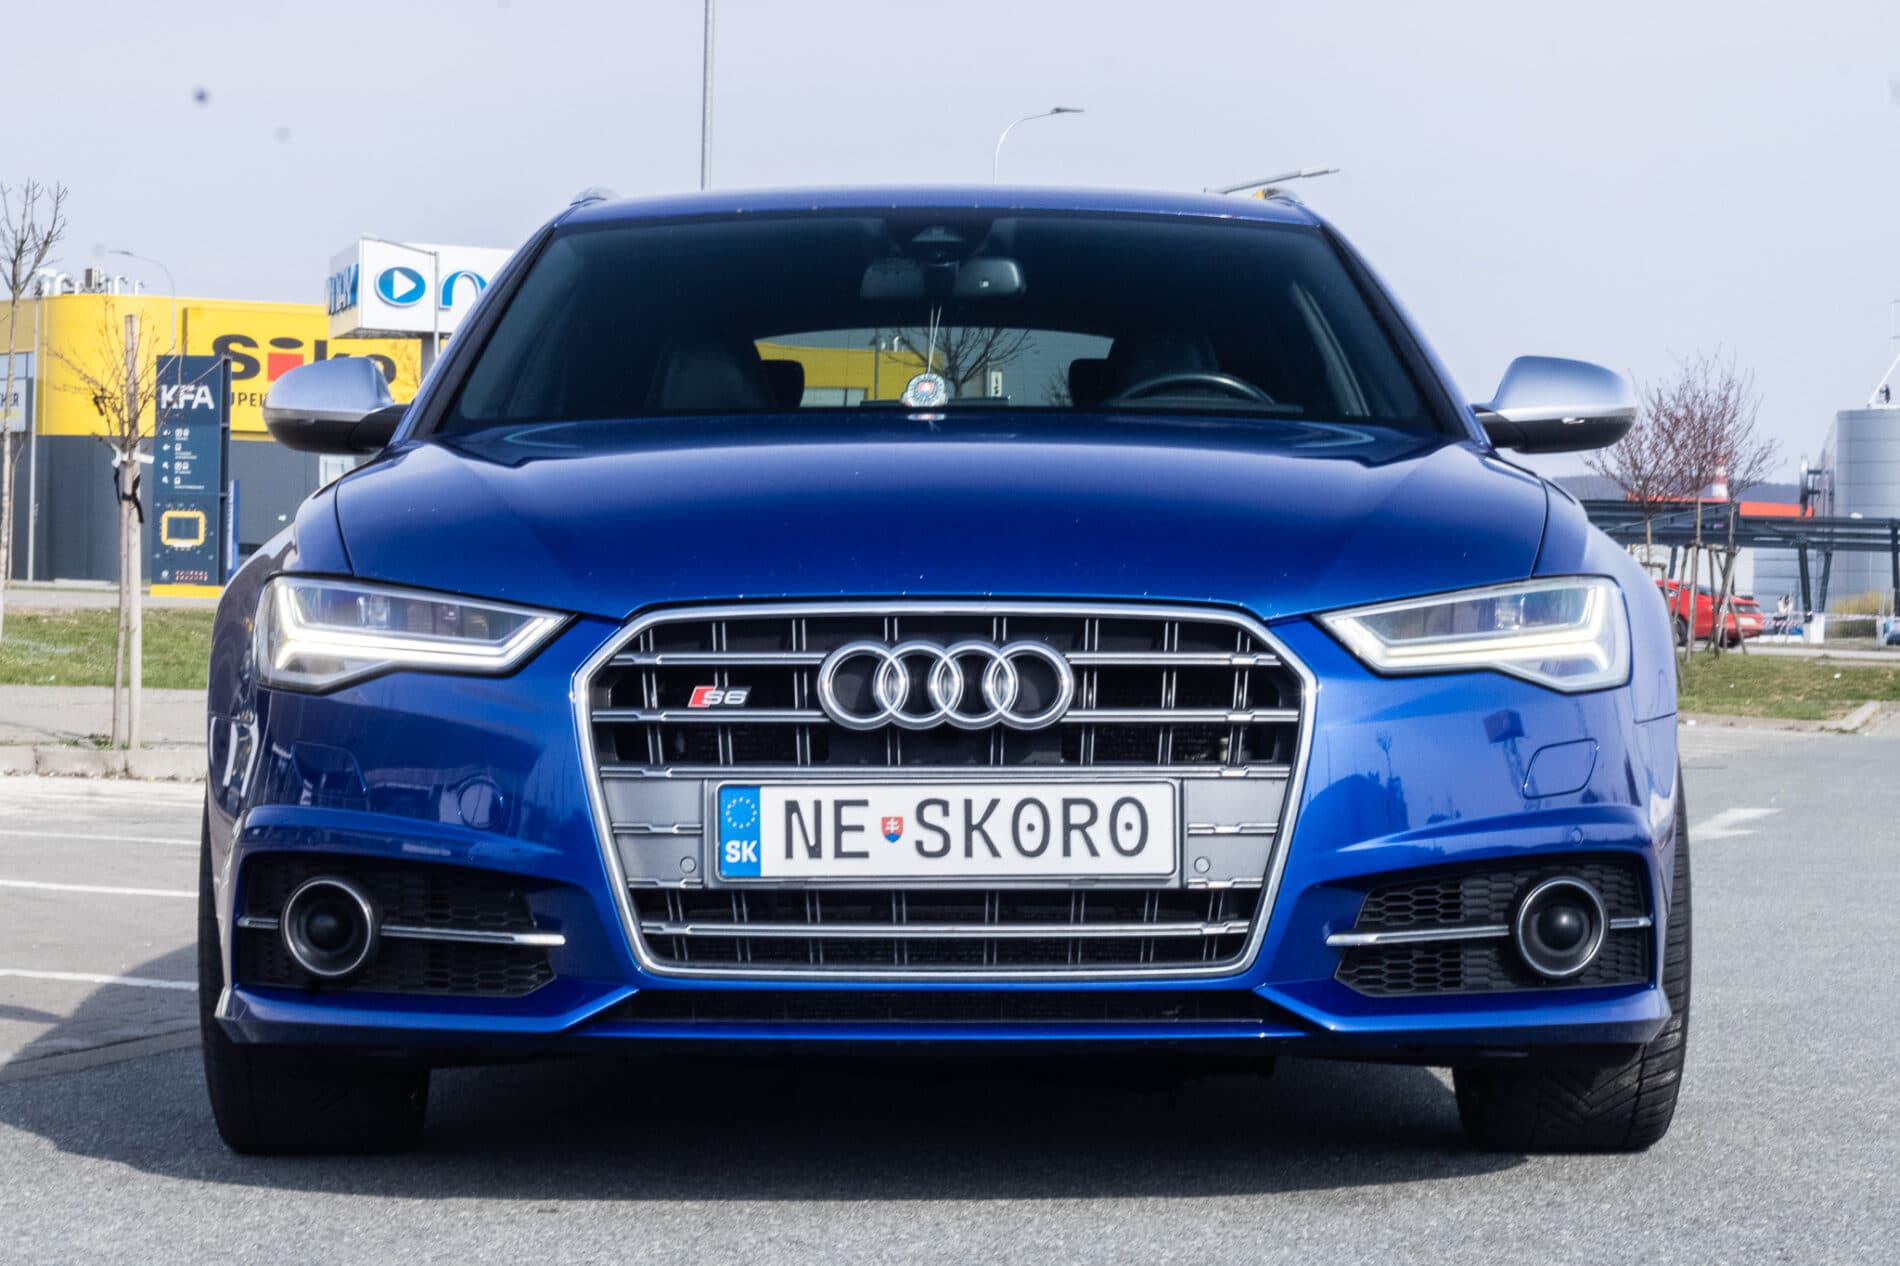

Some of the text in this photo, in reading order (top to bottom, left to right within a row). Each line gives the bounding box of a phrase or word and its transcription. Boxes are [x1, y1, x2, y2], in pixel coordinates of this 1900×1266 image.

[160, 384, 215, 410] KFA
[702, 690, 748, 705] S6
[784, 796, 1150, 860] NE SKORO
[725, 840, 758, 864] SK
